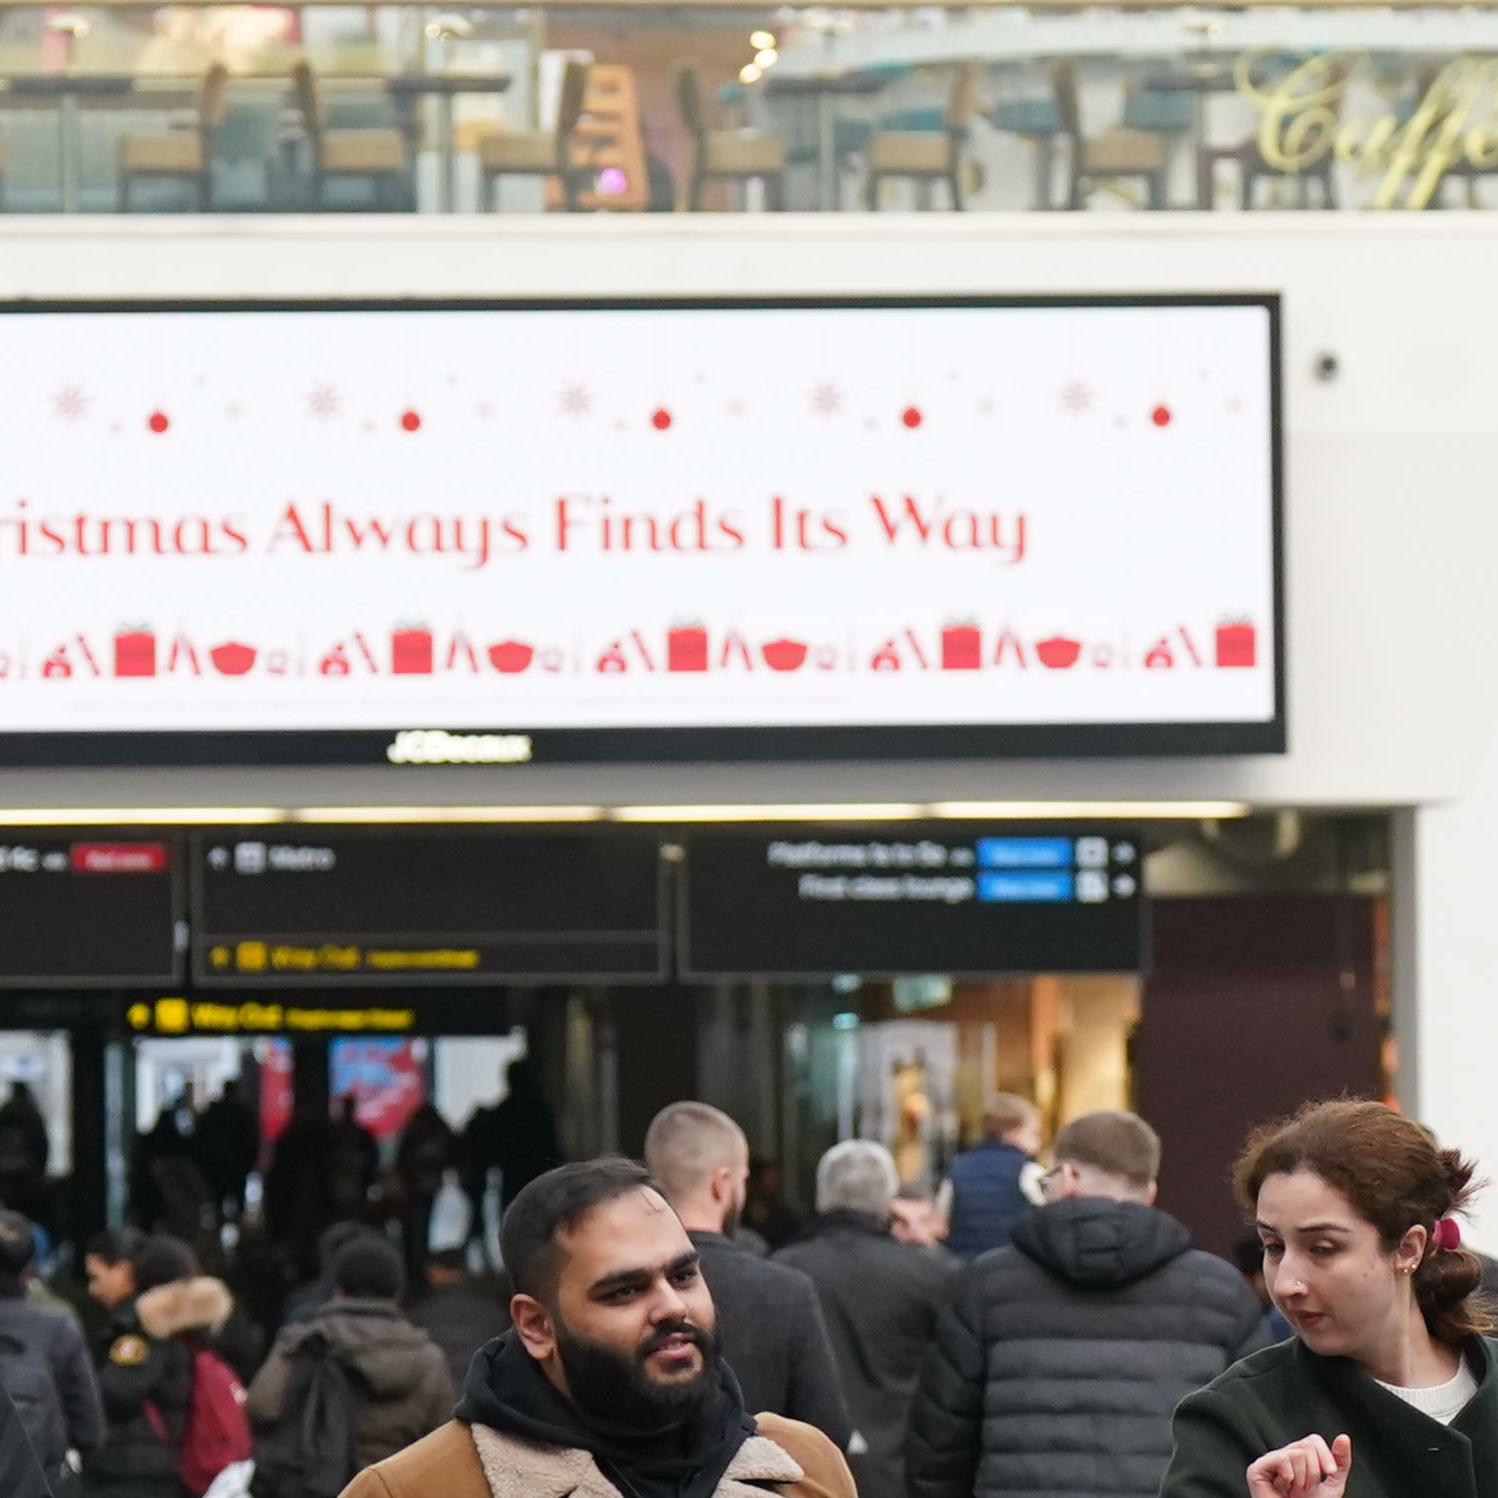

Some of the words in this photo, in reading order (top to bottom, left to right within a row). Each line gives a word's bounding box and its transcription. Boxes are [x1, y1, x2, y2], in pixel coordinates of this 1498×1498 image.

[264, 501, 529, 569] Always
[554, 496, 745, 552] Finds
[771, 495, 850, 552] Its
[869, 493, 1029, 563] Way
